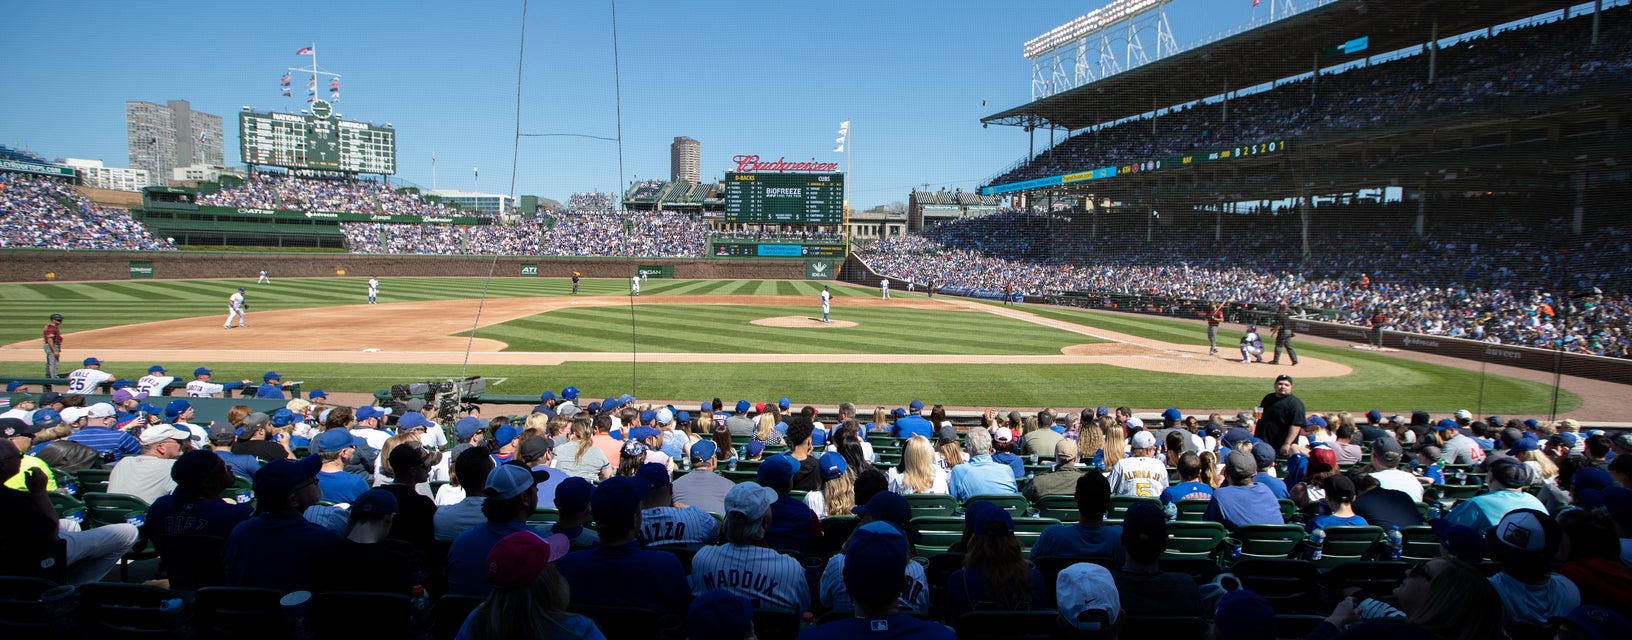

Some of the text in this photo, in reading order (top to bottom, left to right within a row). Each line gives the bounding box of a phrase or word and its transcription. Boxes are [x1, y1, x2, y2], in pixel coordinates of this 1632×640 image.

[273, 113, 304, 122] NATIONAL
[338, 121, 368, 129] AMERICAN
[1183, 156, 1192, 164] RAY
[1235, 148, 1240, 157] B
[1243, 147, 1249, 156] 2
[1252, 145, 1257, 154] S
[1261, 144, 1266, 152] 2
[1280, 141, 1285, 150] 1
[732, 154, 838, 172] Budweiser
[69, 378, 84, 391] 25
[1124, 470, 1151, 481] ALMORA
[1136, 483, 1151, 496] 5
[703, 569, 778, 596] MADDUX
